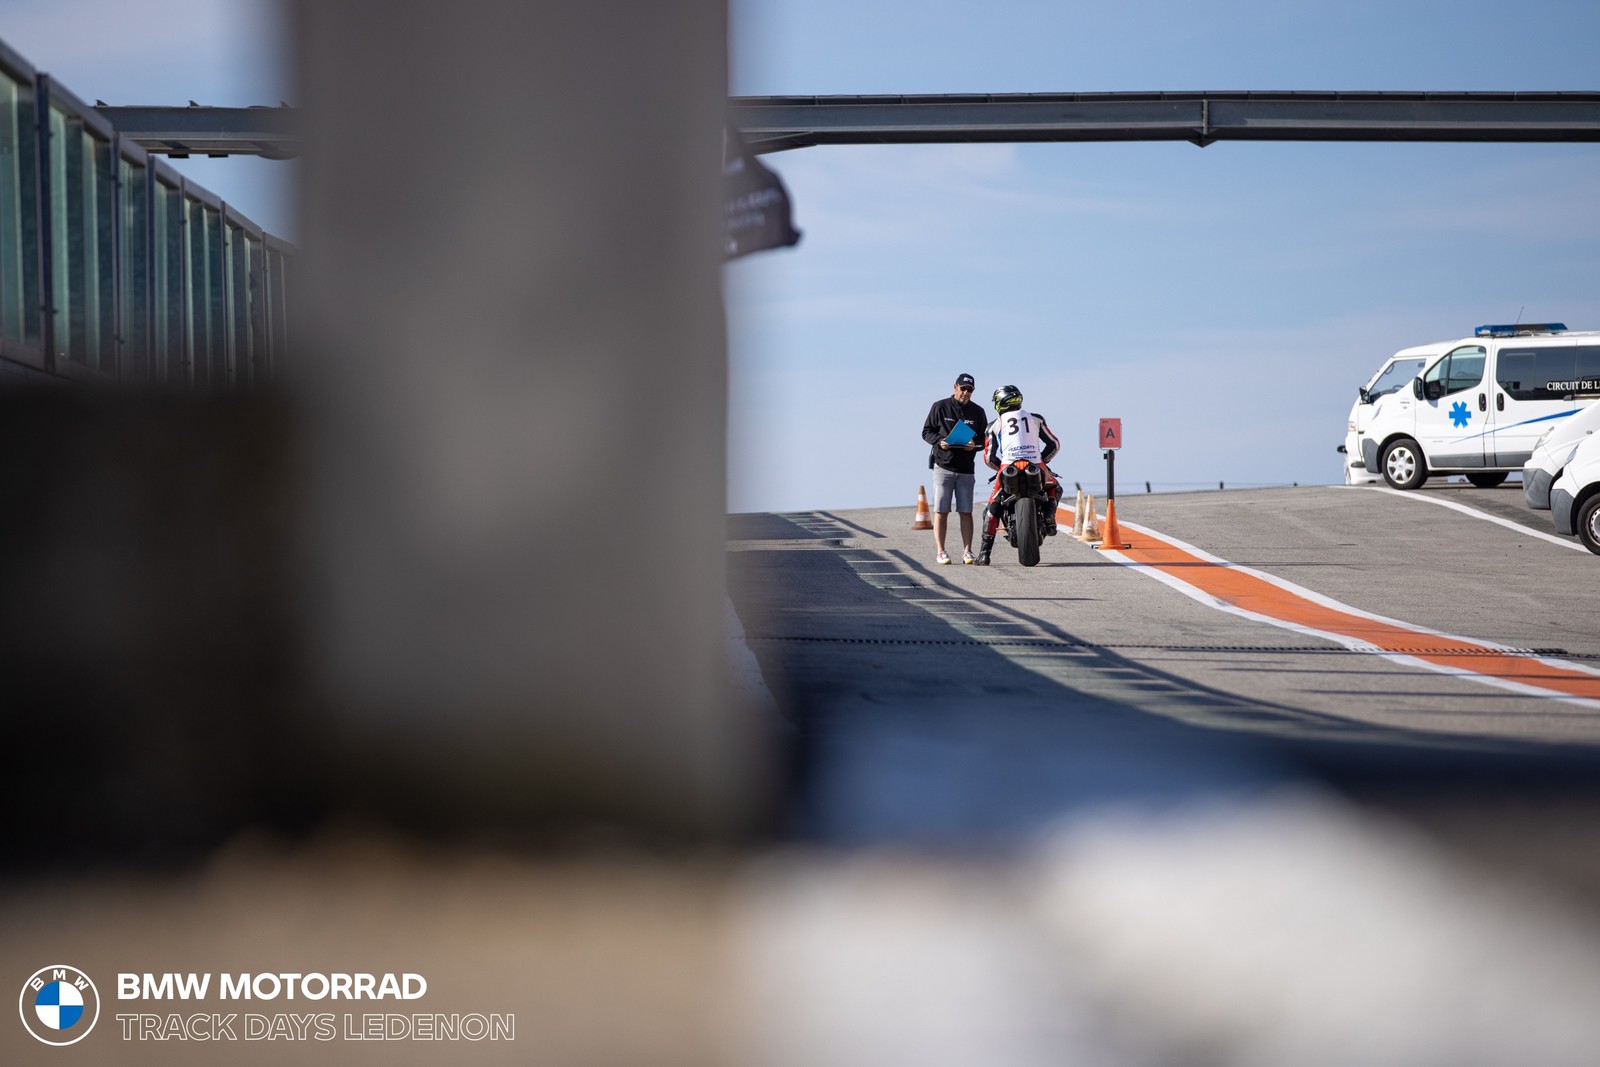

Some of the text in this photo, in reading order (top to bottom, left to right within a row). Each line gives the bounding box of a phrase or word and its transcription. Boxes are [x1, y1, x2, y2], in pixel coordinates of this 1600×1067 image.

[1546, 381, 1600, 391] CIRCUIT DE L
[1007, 416, 1030, 436] 31
[1105, 427, 1116, 439] A
